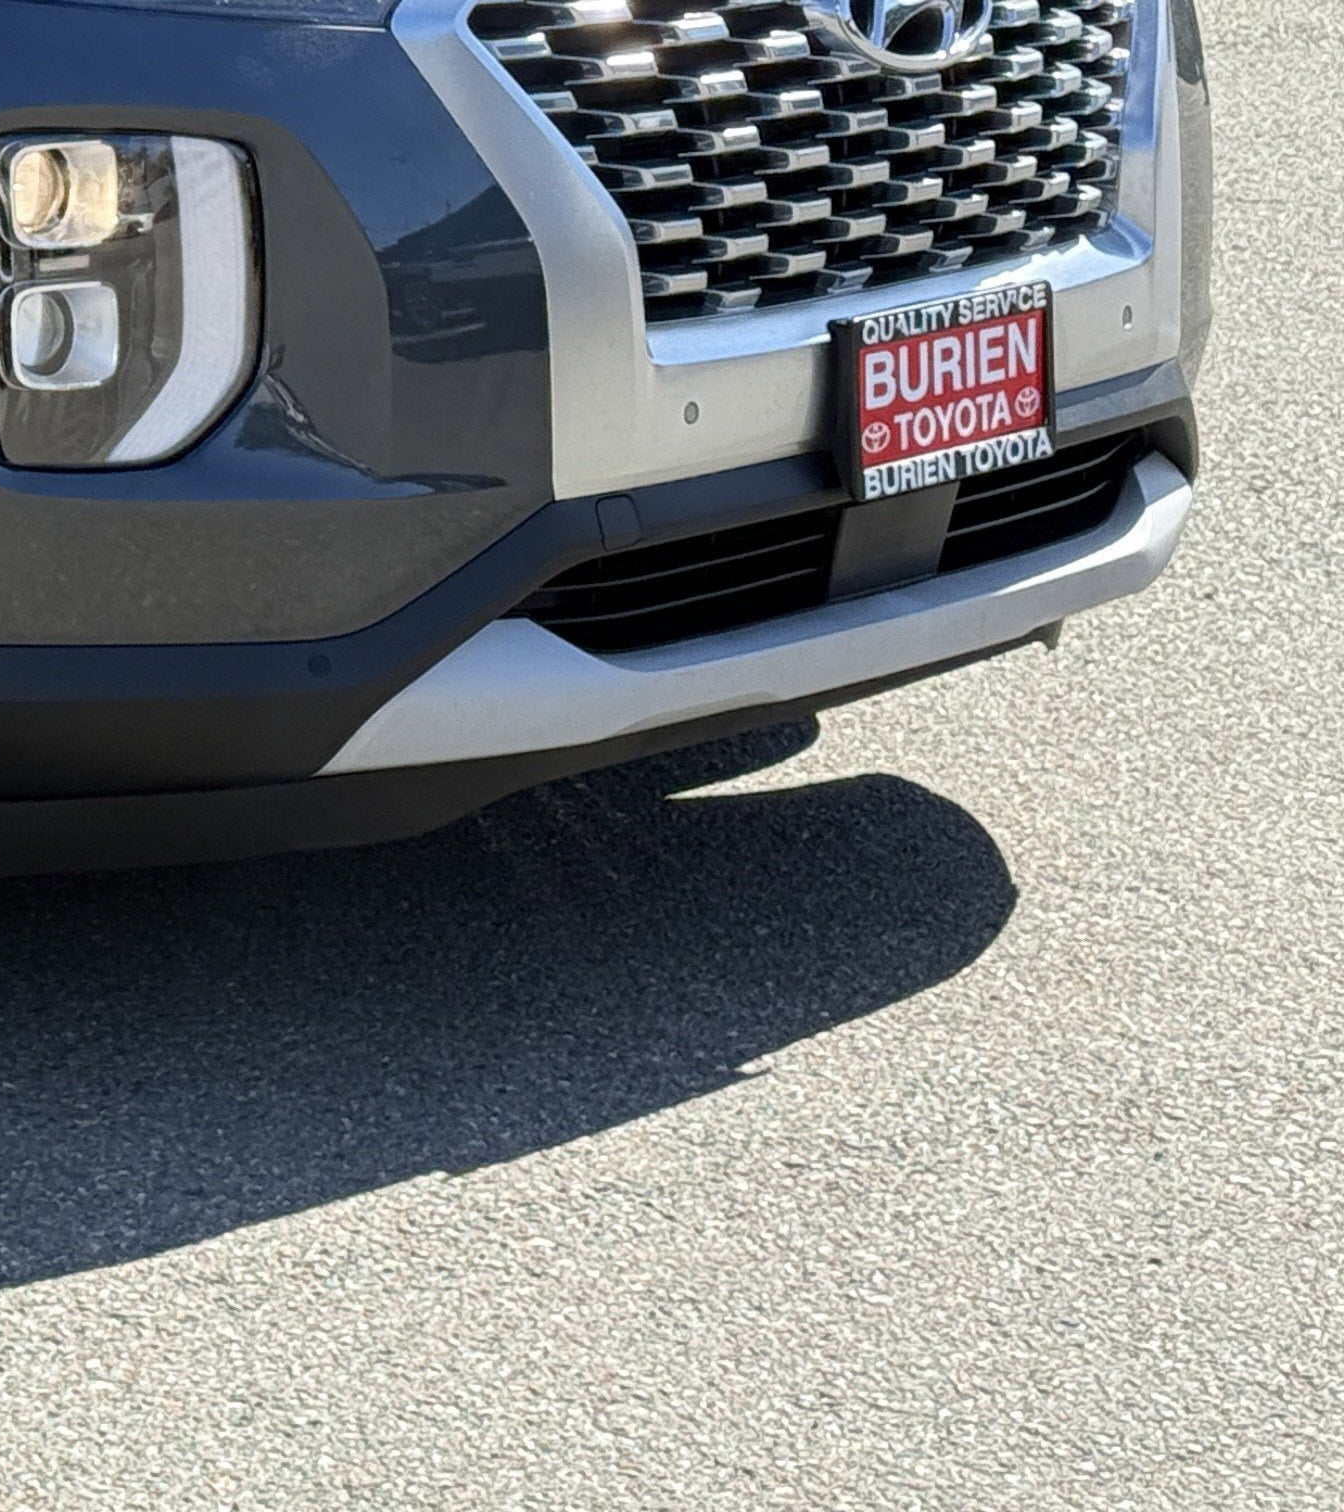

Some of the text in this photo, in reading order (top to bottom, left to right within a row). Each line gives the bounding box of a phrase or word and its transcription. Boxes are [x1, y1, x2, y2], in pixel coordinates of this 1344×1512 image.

[863, 283, 1048, 345] QUALITY SERVICE
[865, 318, 1037, 410] BURIEN
[894, 391, 1012, 451] TOYOTA
[864, 428, 1054, 499] BURIEN TOYOTA
